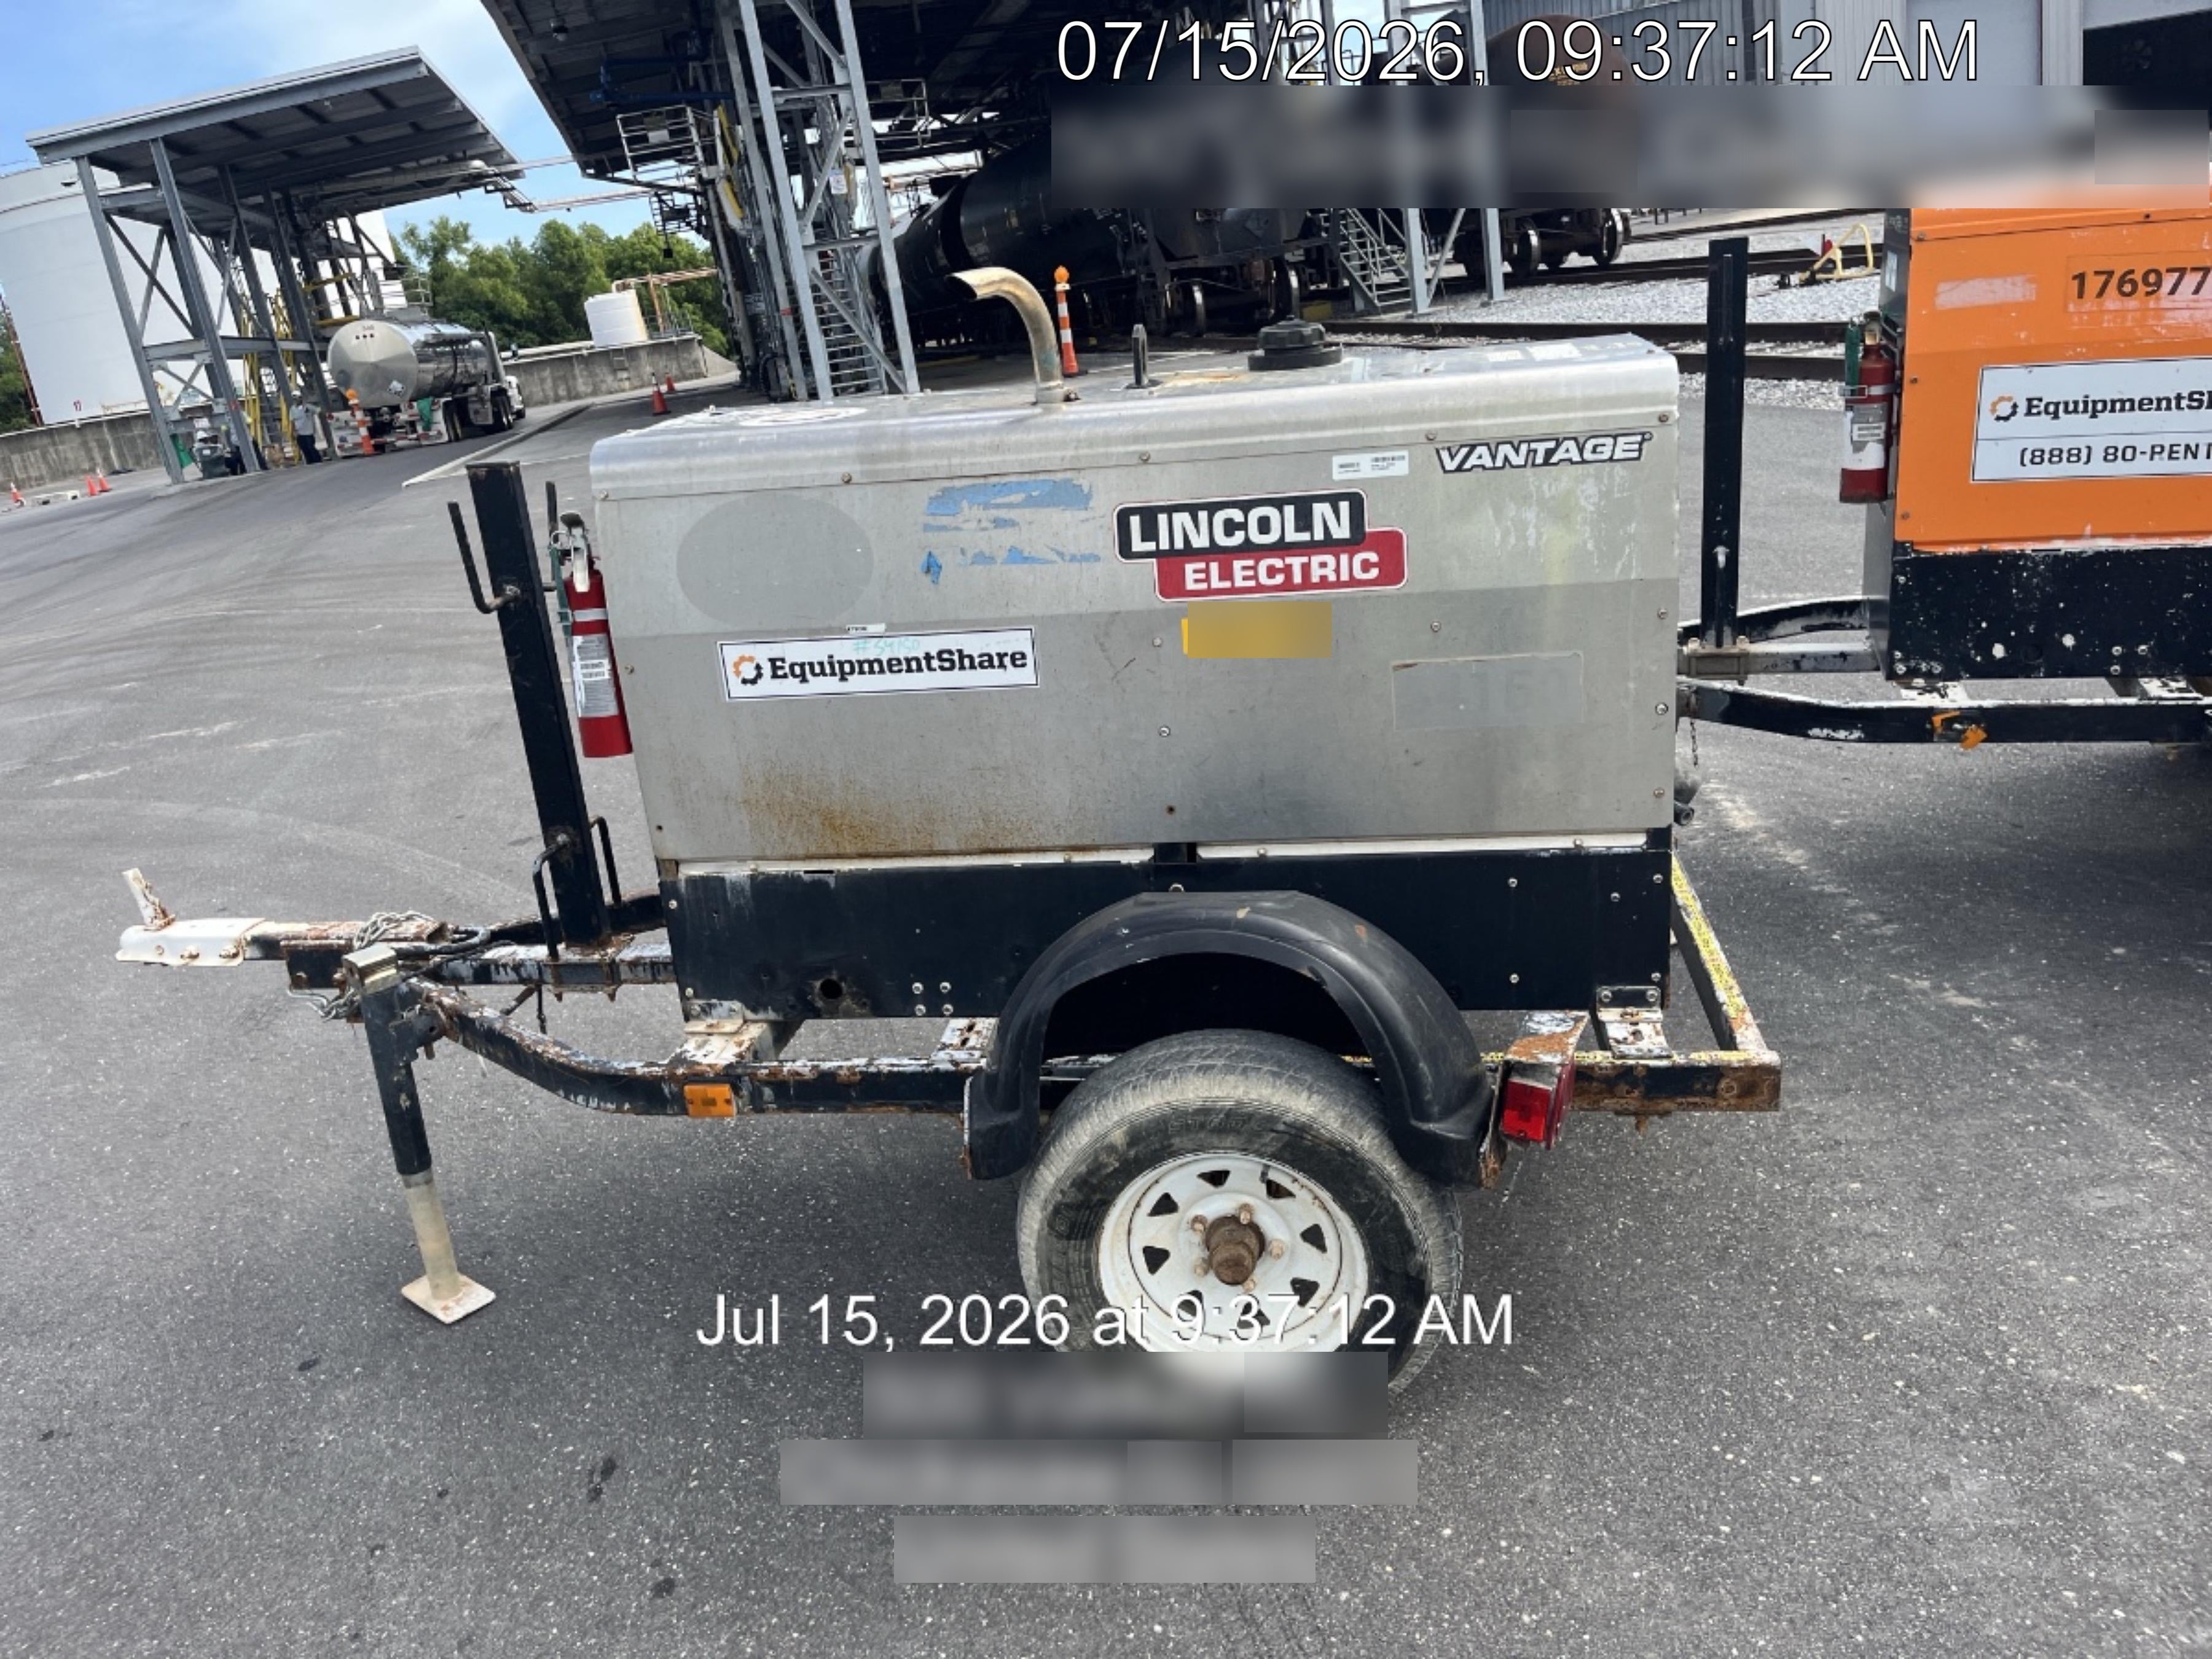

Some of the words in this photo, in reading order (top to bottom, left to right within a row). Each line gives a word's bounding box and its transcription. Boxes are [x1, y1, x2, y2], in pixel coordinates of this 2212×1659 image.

[2071, 266, 2211, 299] 176977
[2020, 445, 2093, 467] (888)
[1129, 500, 1351, 552] LINCOLN
[1184, 551, 1380, 591] ELECTRIC
[769, 648, 1027, 683] EquipmentShare
